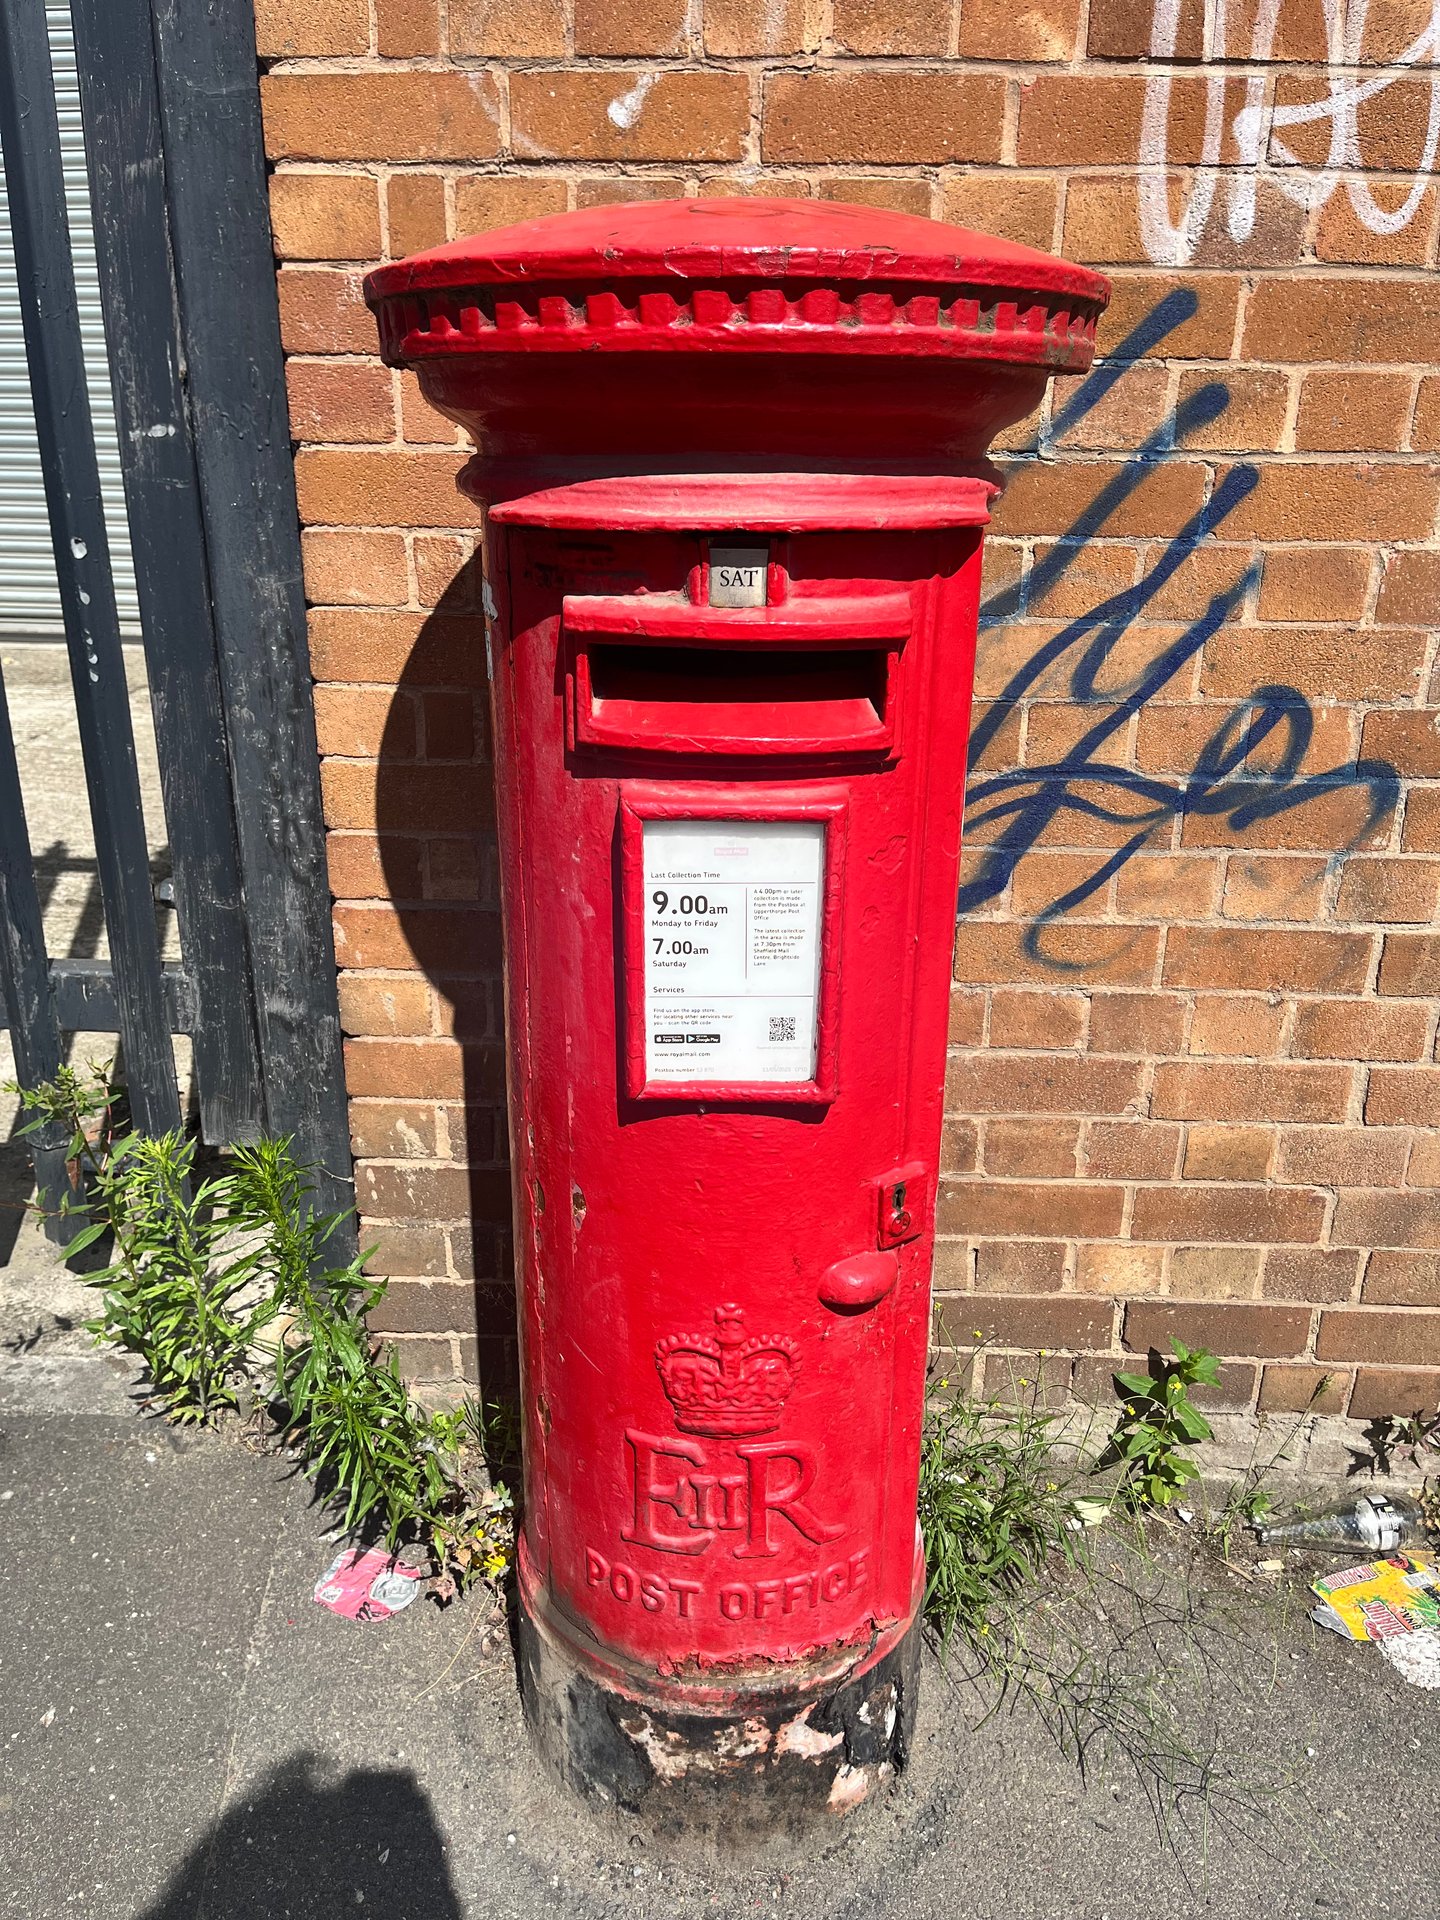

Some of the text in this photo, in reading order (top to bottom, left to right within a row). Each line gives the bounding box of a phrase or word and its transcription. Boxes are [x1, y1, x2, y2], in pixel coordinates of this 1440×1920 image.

[720, 569, 758, 587] SAT
[652, 890, 728, 915] 9.00am
[651, 920, 681, 928] Monday
[694, 920, 718, 928] Friday
[652, 938, 709, 955] 7.00am
[652, 960, 687, 968] Saturday
[653, 986, 685, 994] Services
[585, 1546, 871, 1621] POST OFFICE
